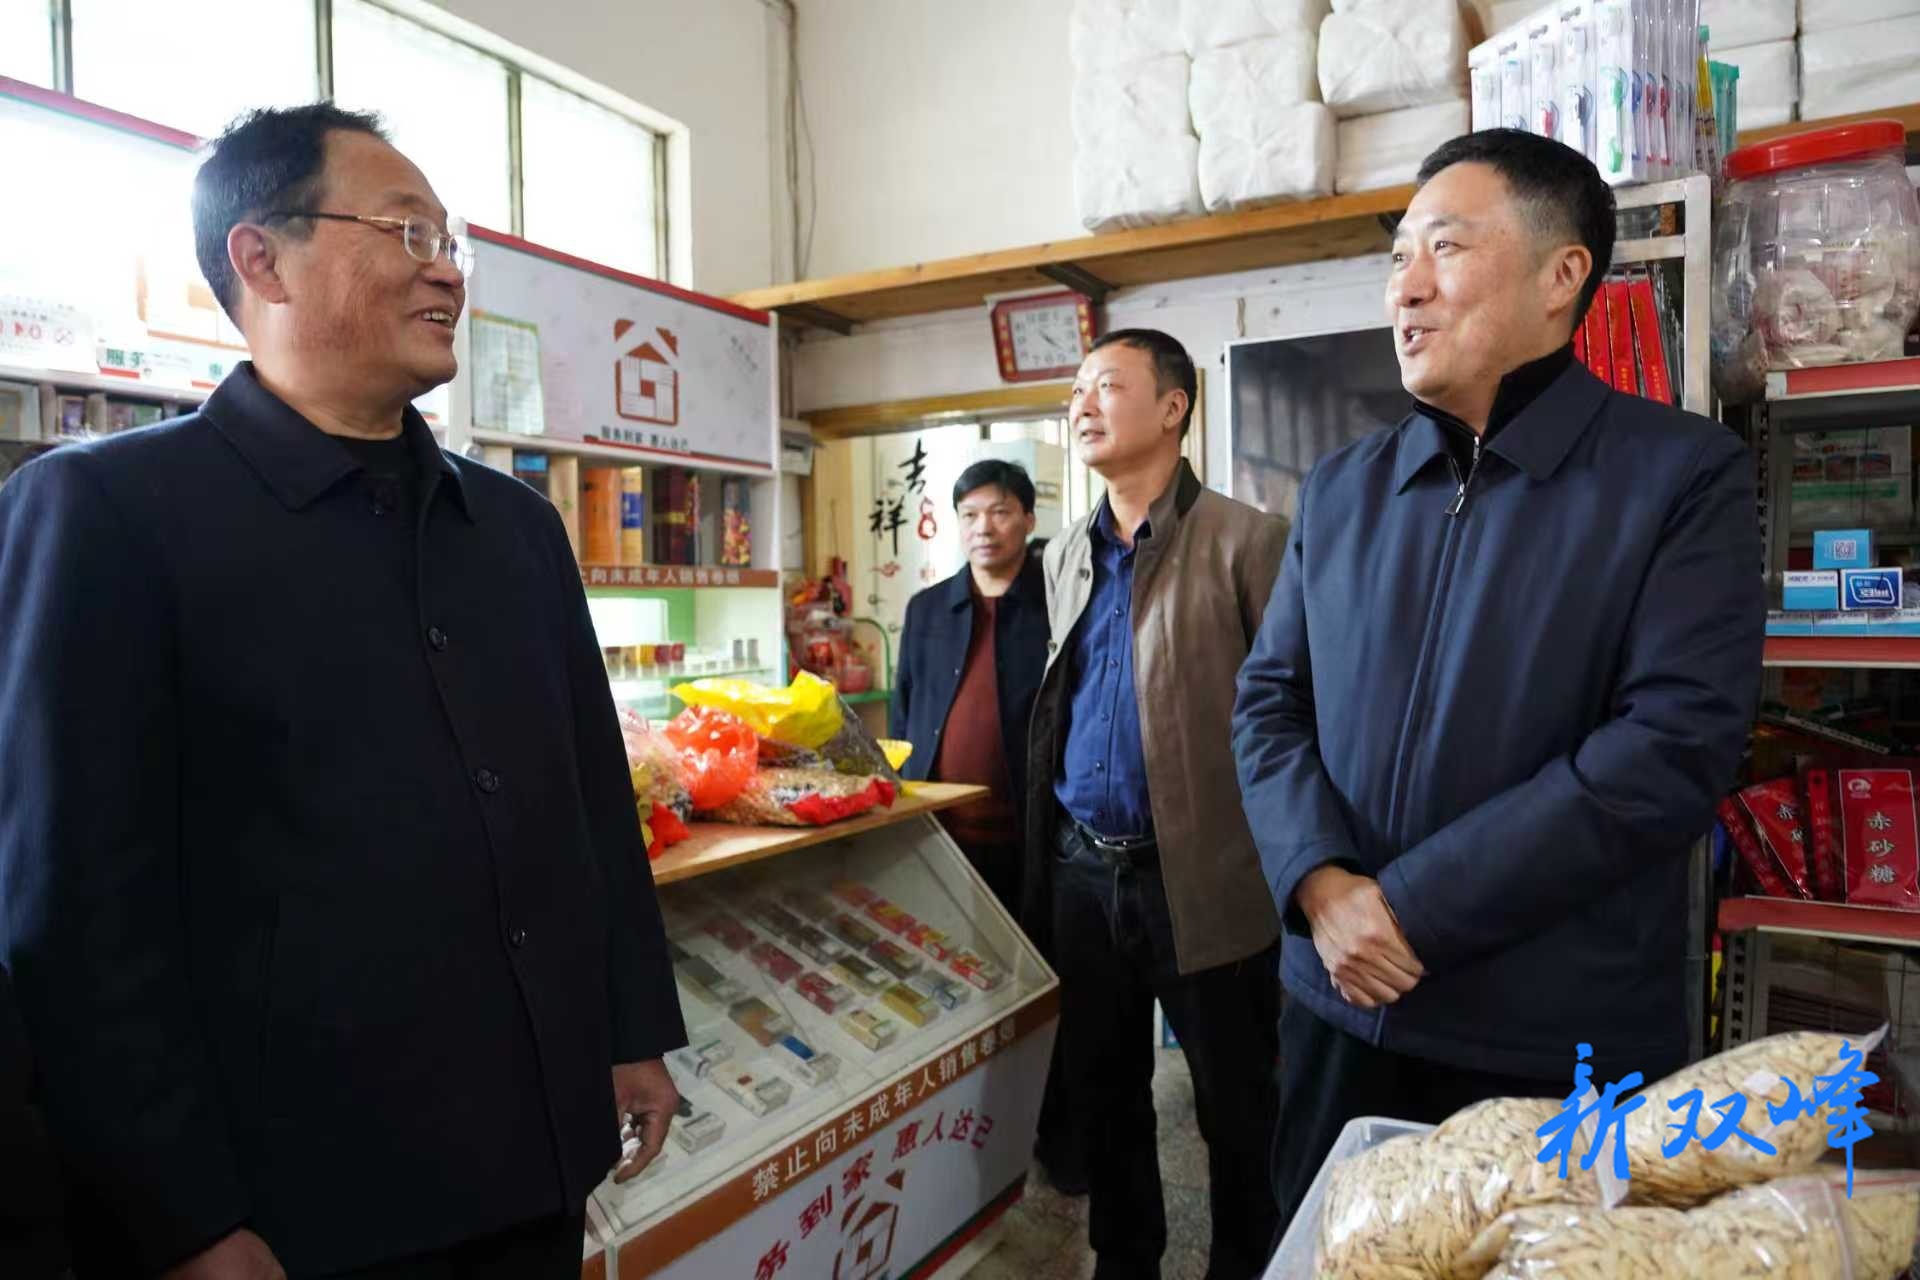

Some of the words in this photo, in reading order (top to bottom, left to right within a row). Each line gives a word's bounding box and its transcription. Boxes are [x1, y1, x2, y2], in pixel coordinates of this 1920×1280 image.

[1866, 811, 1896, 884] 赤砂糖
[752, 1017, 1016, 1200] 禁止向未成年人销售卷烟
